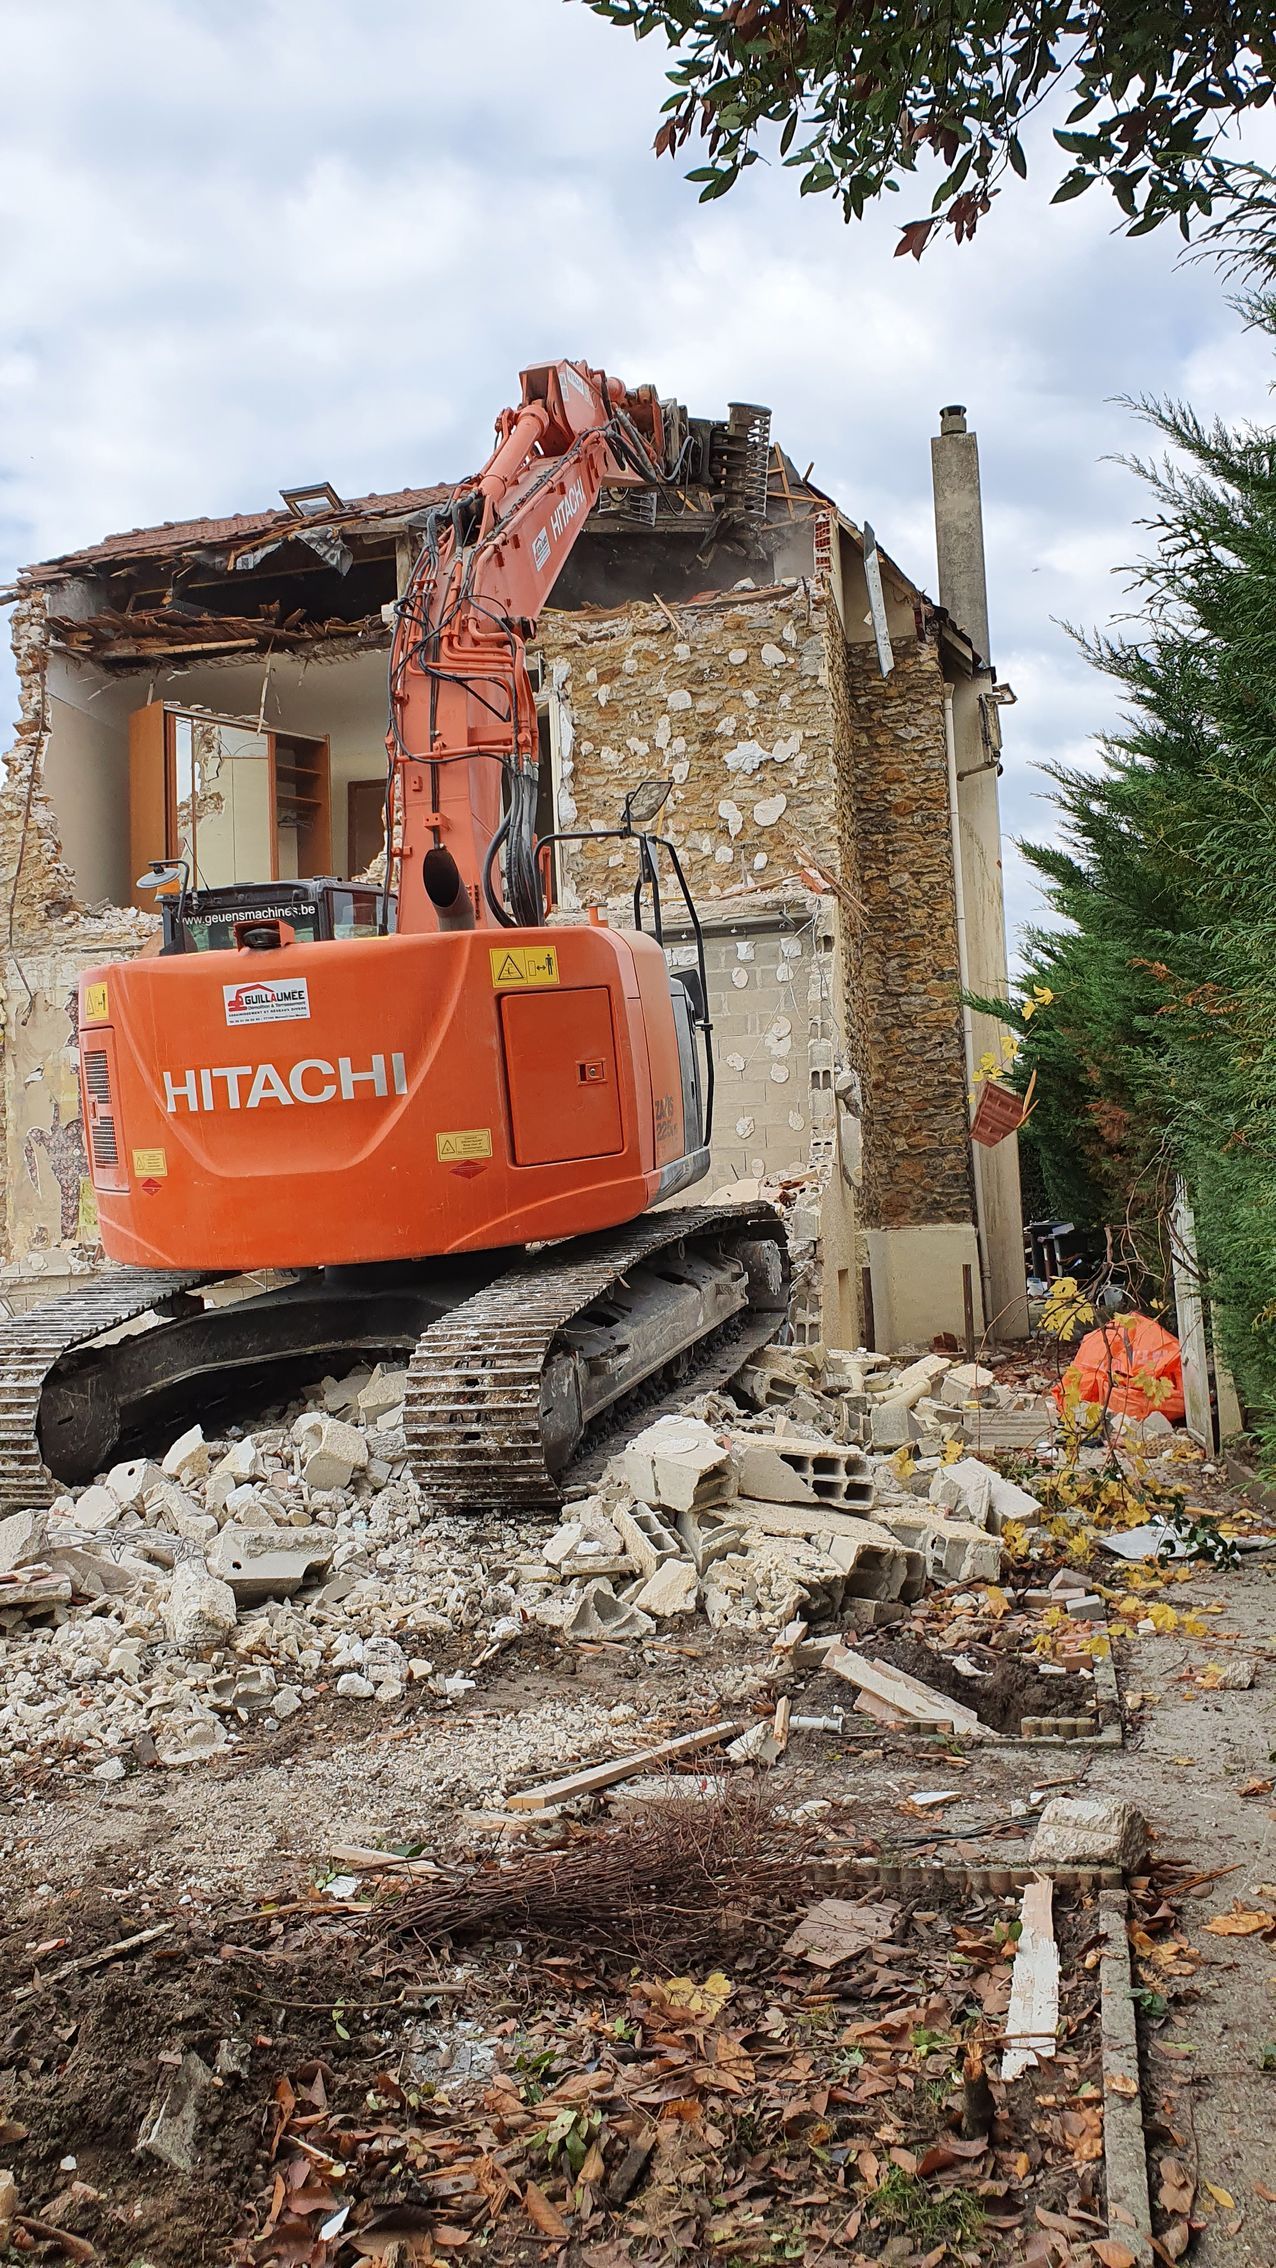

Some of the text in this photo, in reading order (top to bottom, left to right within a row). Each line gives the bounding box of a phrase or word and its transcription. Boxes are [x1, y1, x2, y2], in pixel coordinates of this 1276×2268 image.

[550, 476, 587, 541] HITACHI
[175, 904, 316, 927] ww.geuensmachines.be
[163, 1052, 408, 1113] HITACHI
